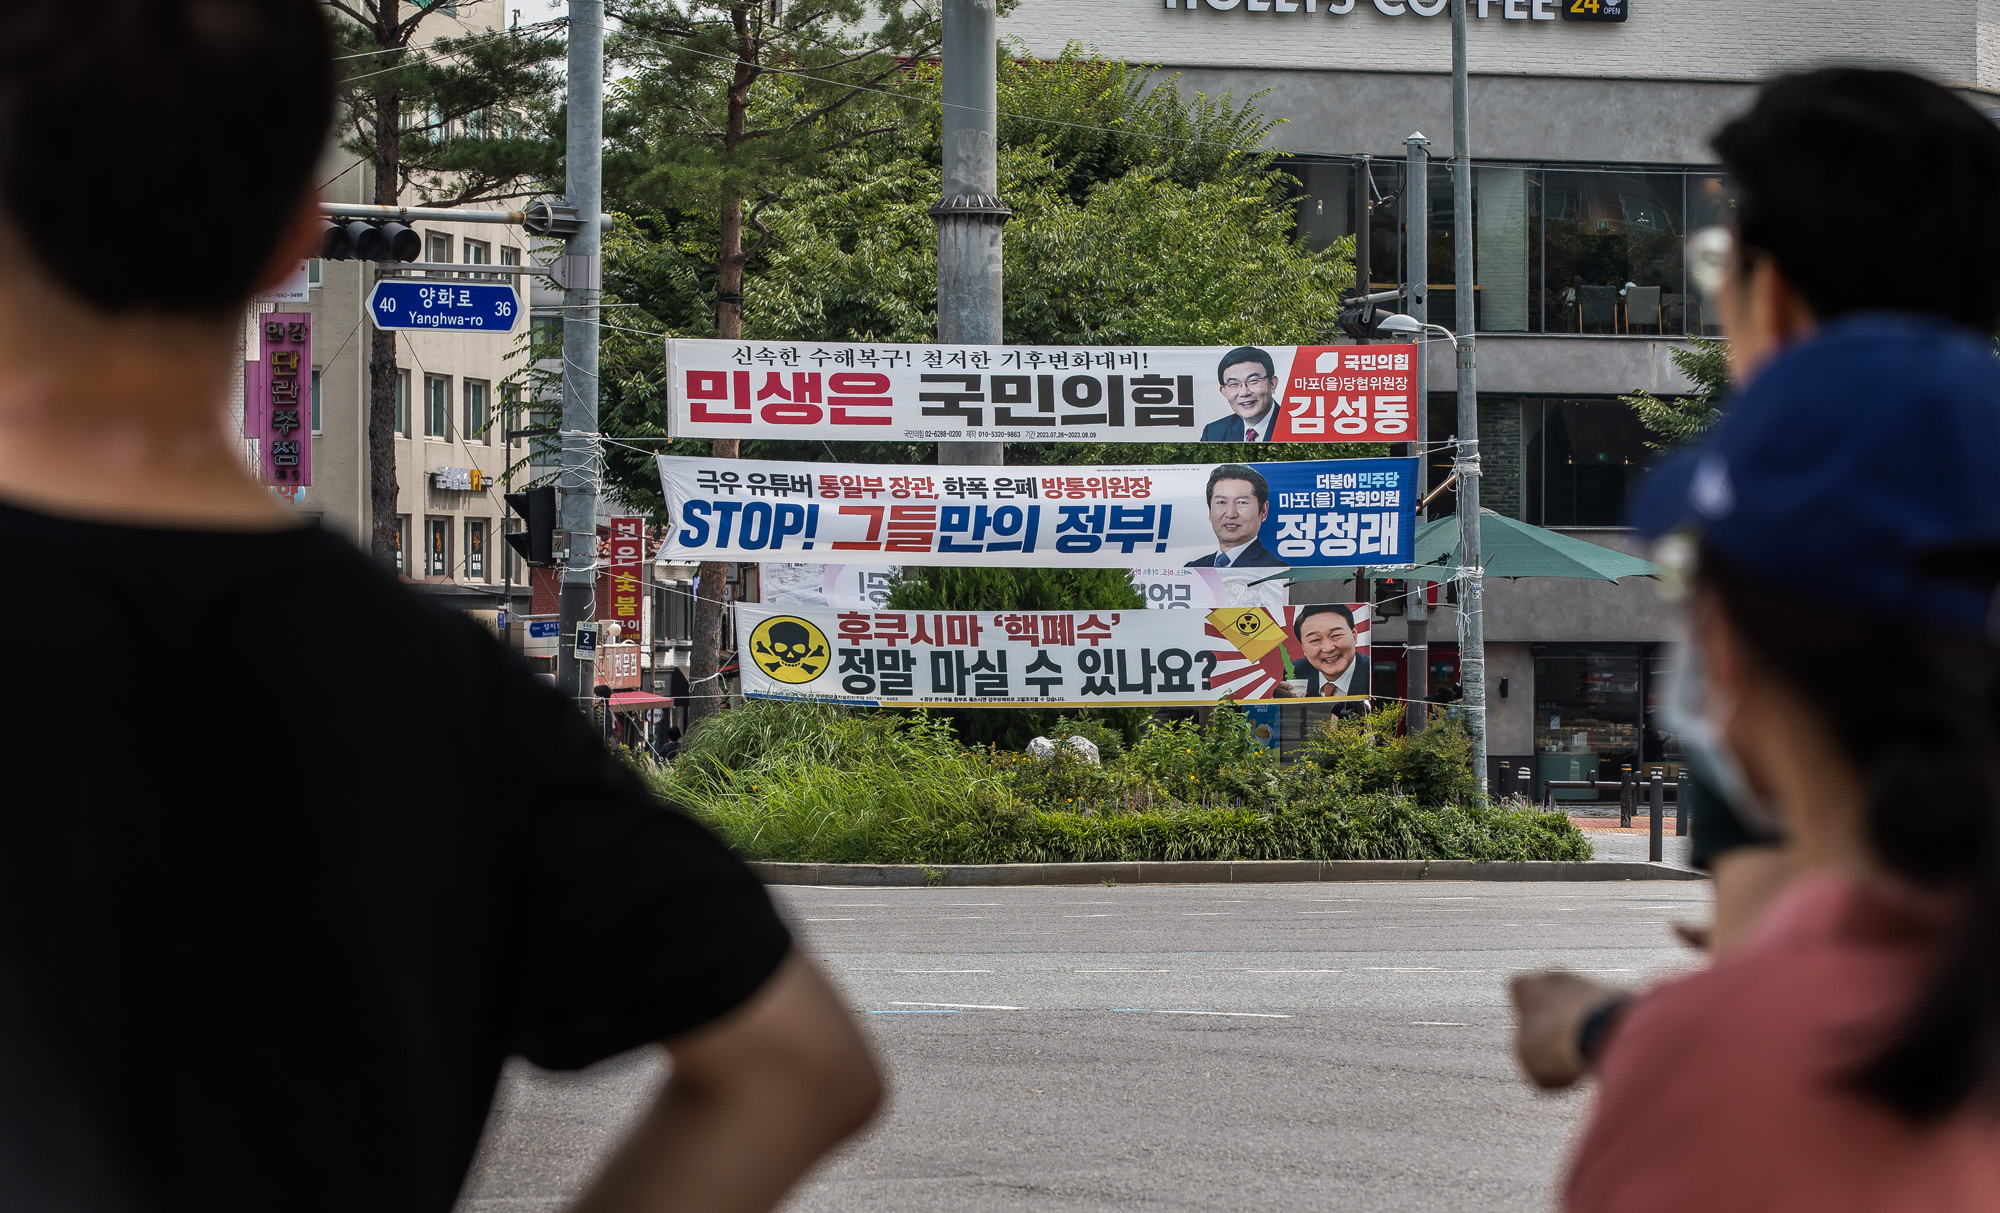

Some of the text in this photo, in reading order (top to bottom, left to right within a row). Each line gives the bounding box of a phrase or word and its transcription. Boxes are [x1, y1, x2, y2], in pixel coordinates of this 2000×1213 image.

[379, 297, 396, 313] 40
[419, 287, 473, 308] 양화로
[494, 301, 511, 317] 36
[408, 311, 483, 327] Yanghwa-ro
[265, 322, 308, 342] 한강
[731, 346, 1149, 371] 신속한 수해복구! 철저한 기후변화대비!
[1344, 354, 1409, 371] 국민의힘
[1294, 377, 1408, 391] 마포(을)당협위원장
[271, 351, 299, 466] 단란주점
[686, 370, 1194, 427] 민생은 국민의힘
[1288, 396, 1410, 434] 김성동
[904, 430, 924, 438] 국민의힘
[925, 430, 962, 438] 02-6288-0200
[965, 430, 977, 438] 제작
[1025, 430, 1036, 439] 기간
[696, 470, 1152, 499] 극우 유튜버 통일부 장관, 학폭 은폐 방통위원장
[1279, 490, 1400, 508] 마포(을) 국회의원
[678, 499, 1175, 553] STOP! 그들만의 정부!
[1276, 512, 1399, 557] 정청래
[615, 523, 638, 567] 보은
[614, 571, 638, 616] 숯불
[583, 633, 590, 643] 2
[837, 611, 983, 647] 후쿠시마
[838, 648, 1217, 697] 정말 마실 수 있나요?
